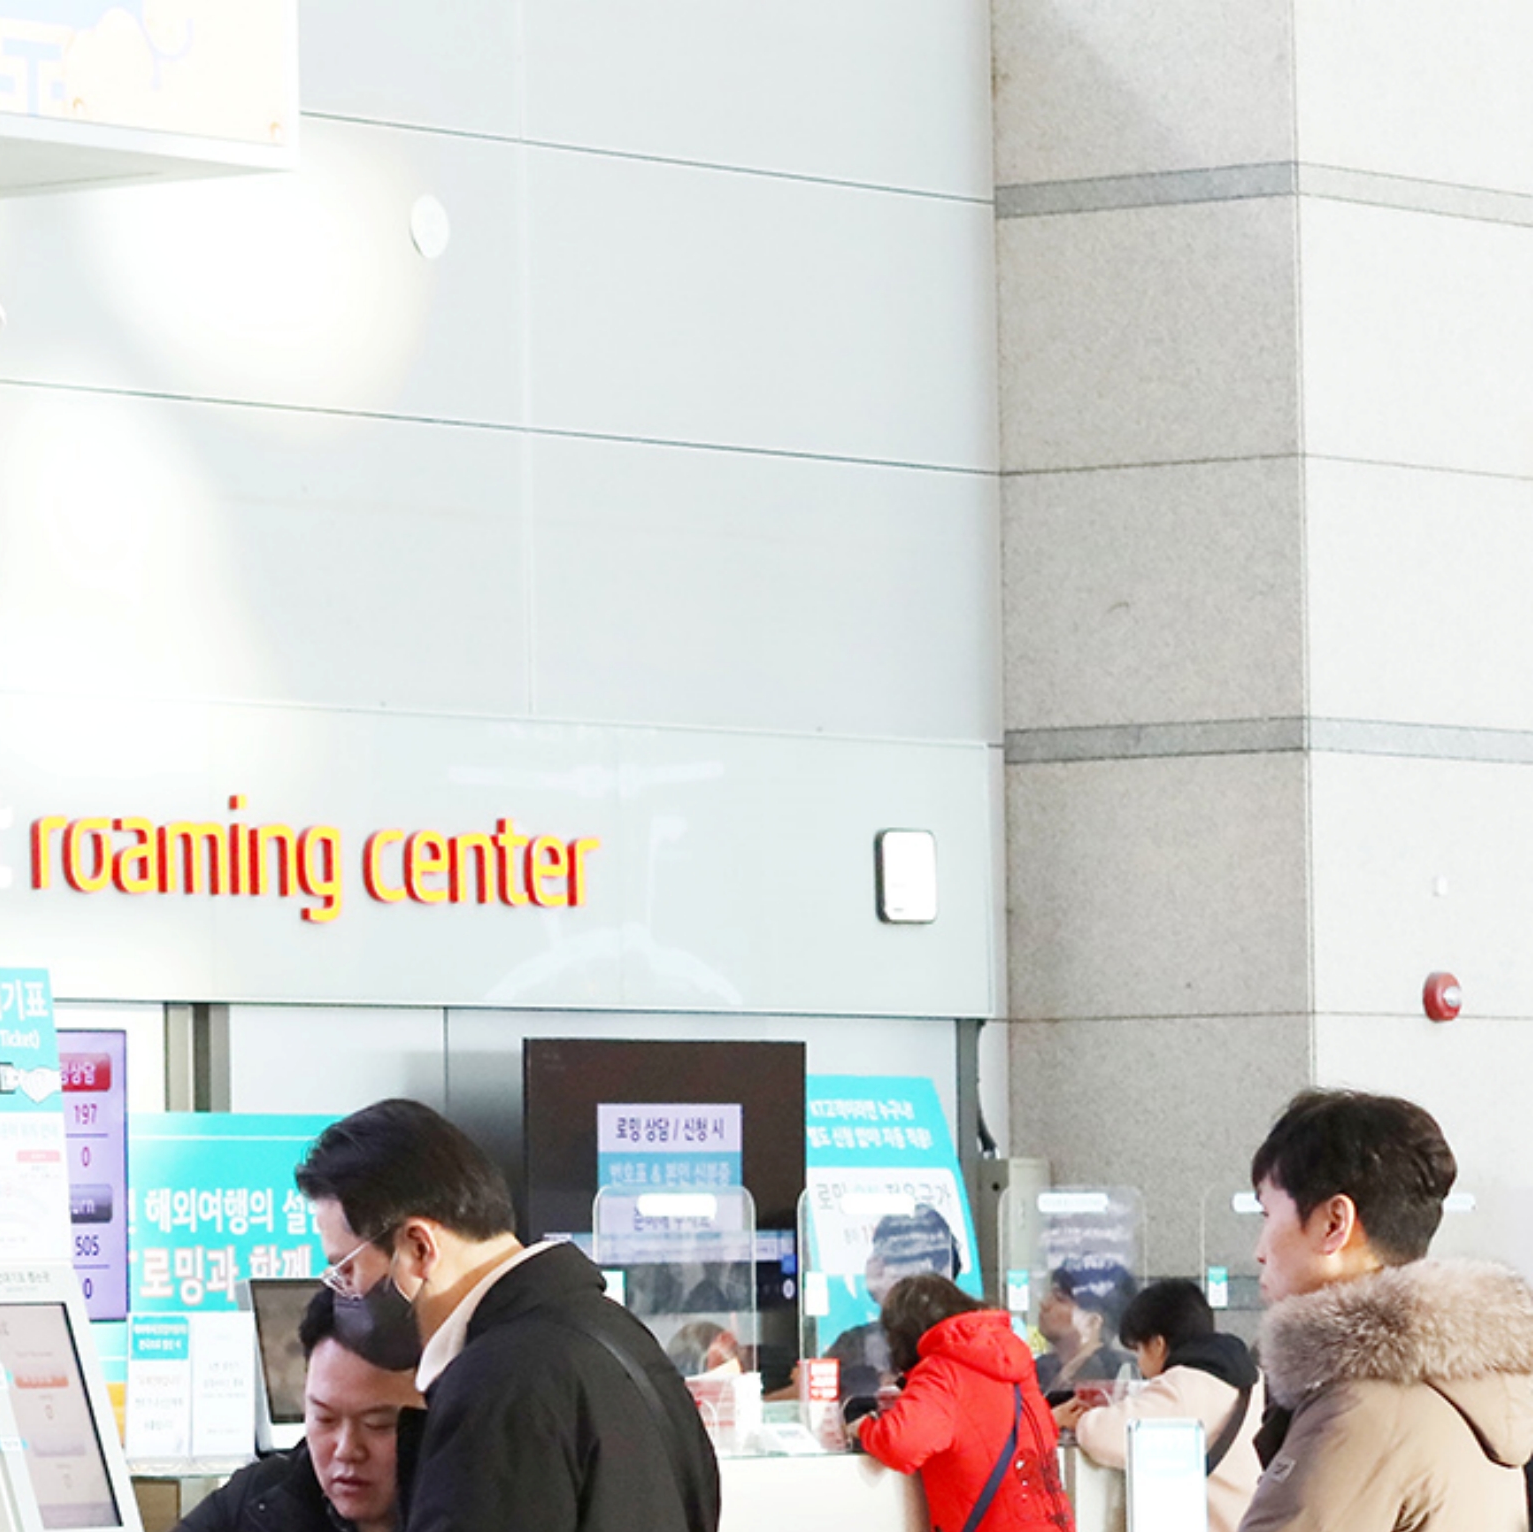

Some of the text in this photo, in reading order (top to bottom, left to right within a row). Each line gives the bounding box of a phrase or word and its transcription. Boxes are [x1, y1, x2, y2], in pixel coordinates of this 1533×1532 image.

[29, 795, 343, 923] roaming
[363, 817, 602, 907] center
[73, 1103, 98, 1125] 197
[615, 1117, 642, 1143] 로밍
[644, 1117, 670, 1143] 상담
[683, 1117, 708, 1143] 신청
[712, 1117, 725, 1140] 시
[144, 1187, 274, 1236] 해외여행의
[74, 1234, 101, 1257] 505
[139, 1244, 240, 1306] 로밍과
